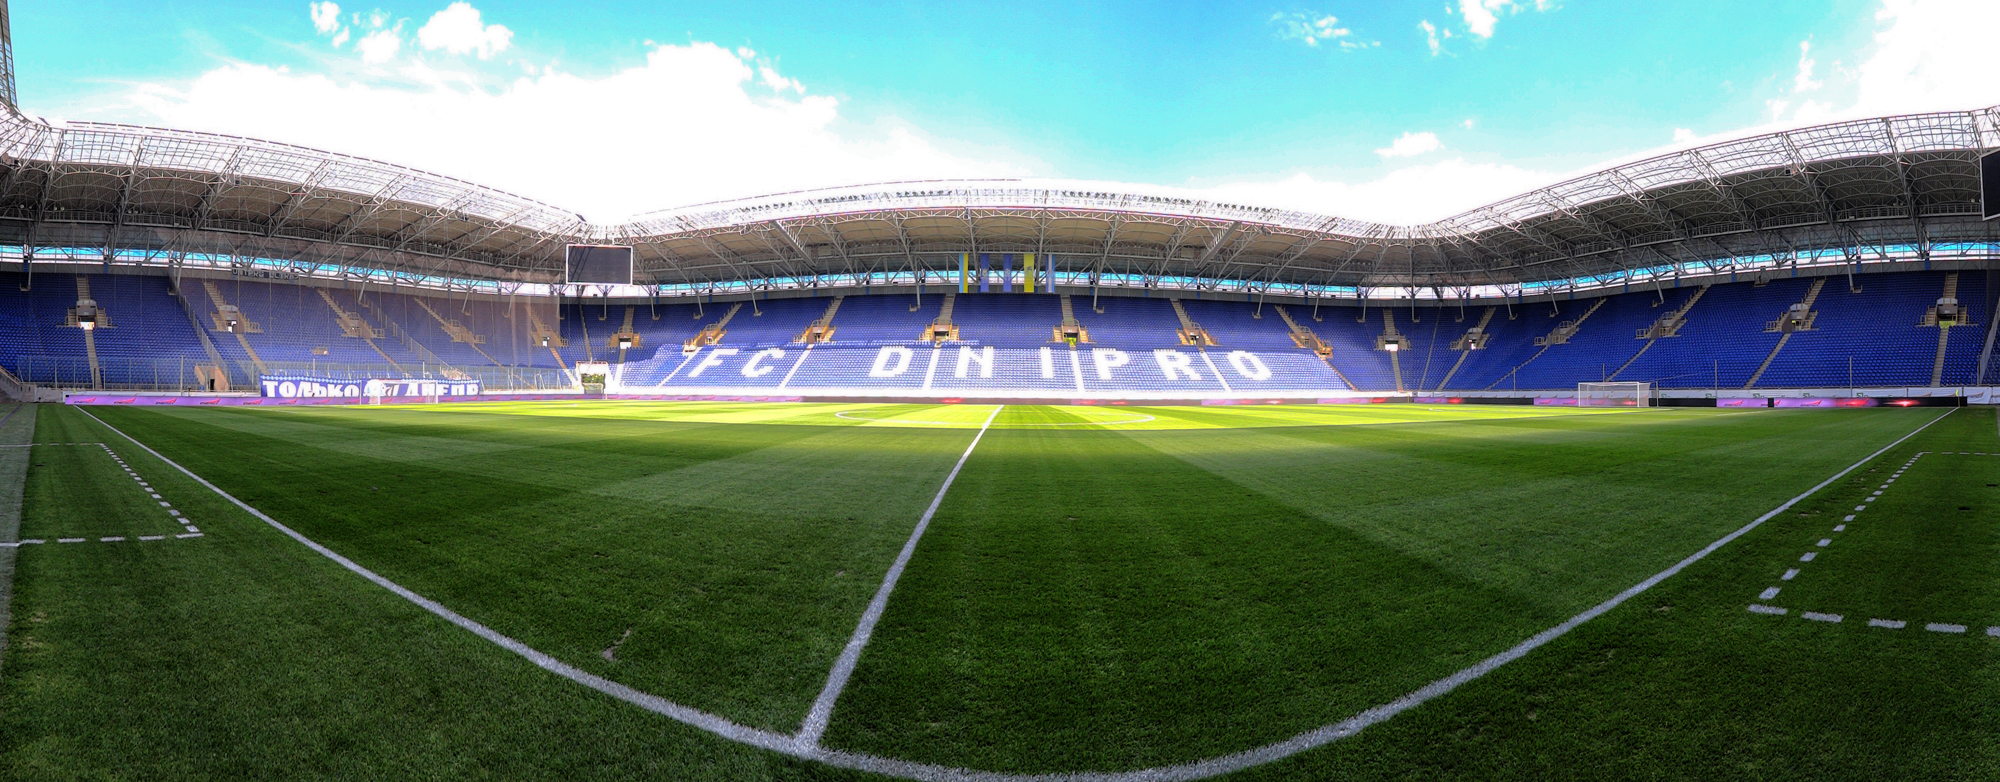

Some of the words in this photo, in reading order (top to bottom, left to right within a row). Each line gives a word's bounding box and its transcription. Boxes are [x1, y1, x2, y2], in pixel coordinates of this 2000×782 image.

[688, 348, 786, 377] FC
[869, 346, 1272, 381] DNIPRO
[263, 380, 360, 397] ТОЛЬКО
